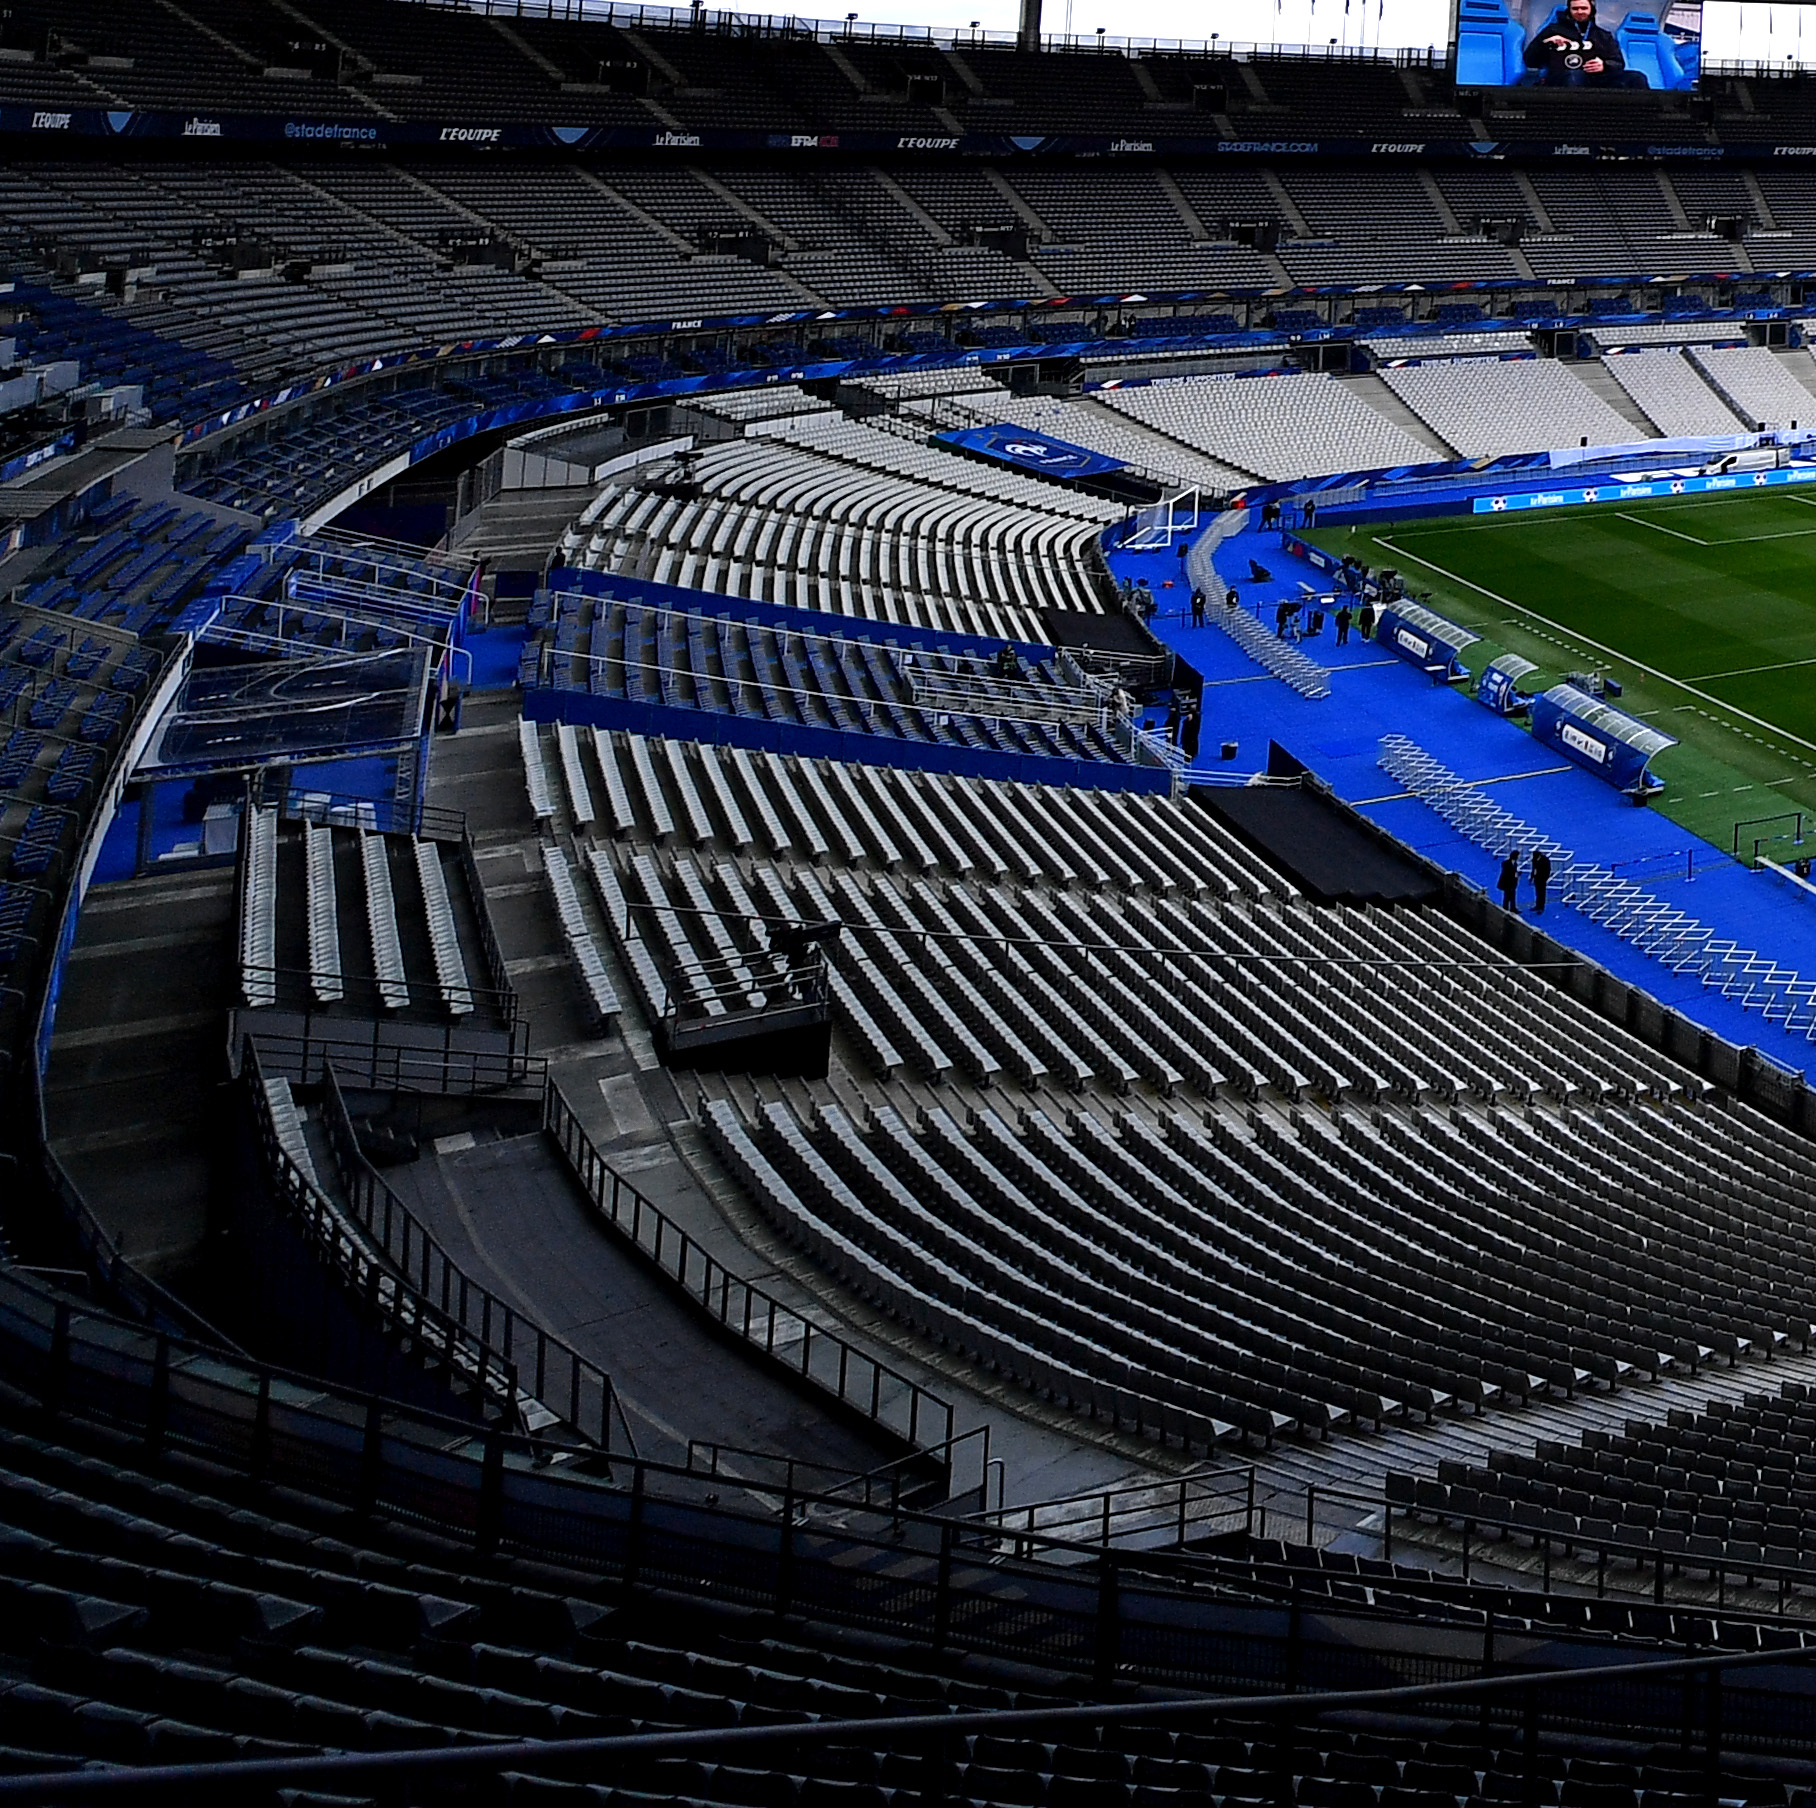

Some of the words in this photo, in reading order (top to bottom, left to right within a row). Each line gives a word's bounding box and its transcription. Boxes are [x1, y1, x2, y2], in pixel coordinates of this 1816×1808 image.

[284, 123, 377, 140] @stadefrance
[439, 128, 502, 142] L'ÉQUIPE
[897, 137, 960, 150] L'ÉQUIPE
[672, 320, 703, 329] FRANCE
